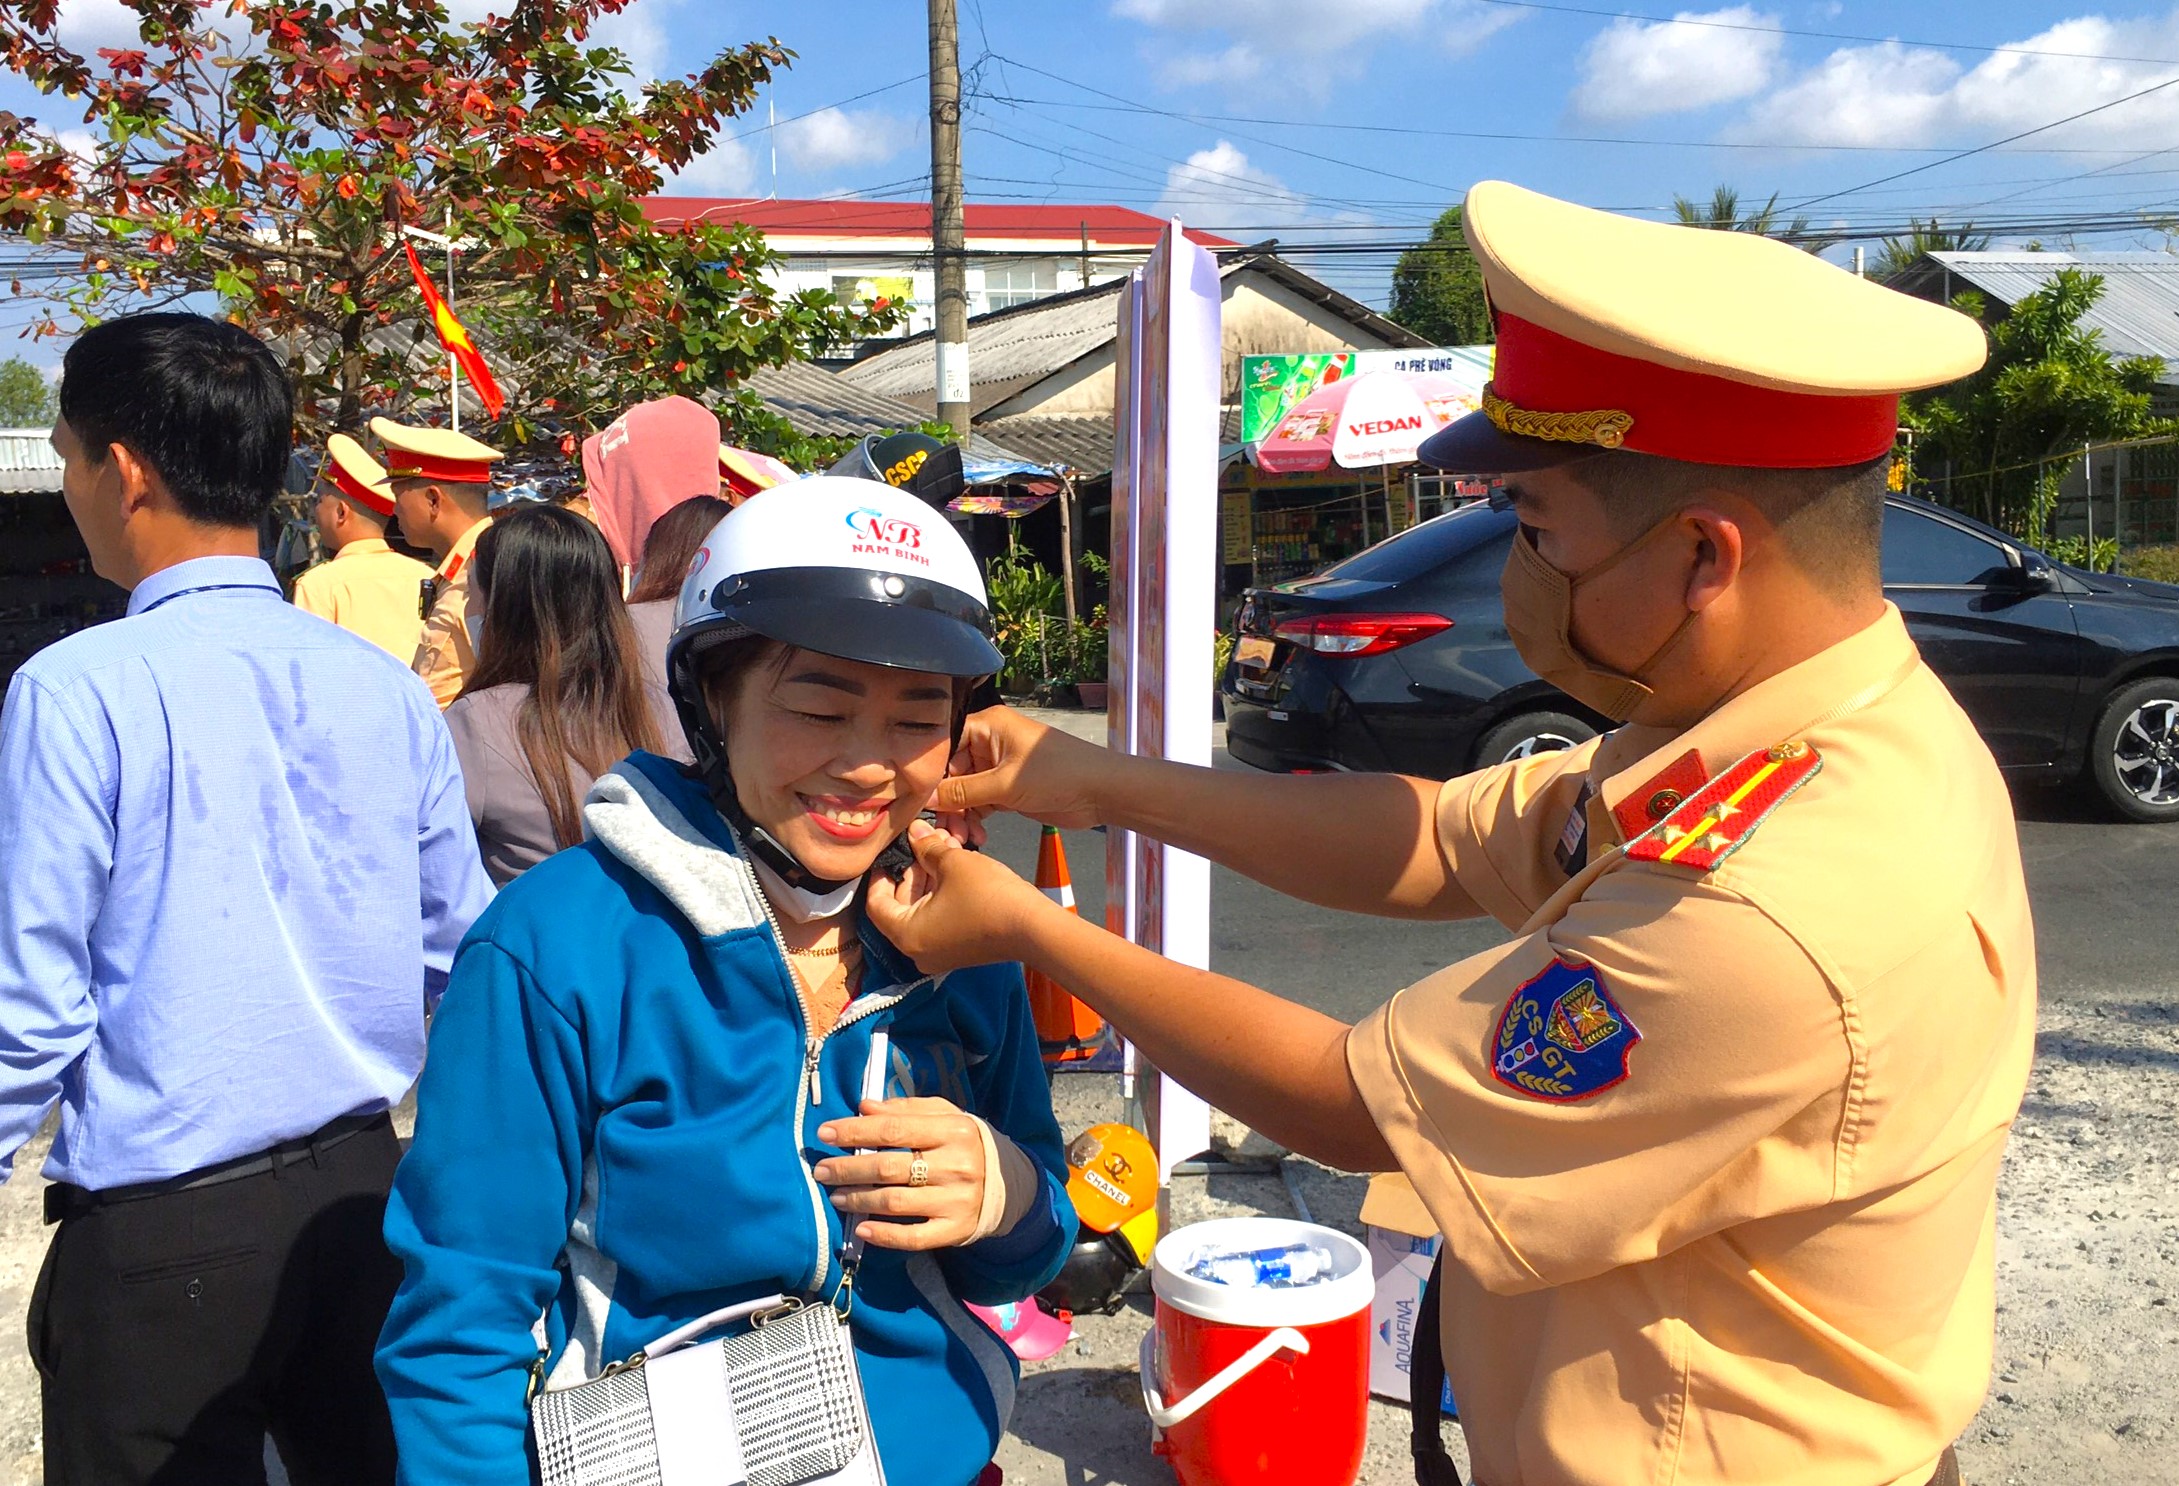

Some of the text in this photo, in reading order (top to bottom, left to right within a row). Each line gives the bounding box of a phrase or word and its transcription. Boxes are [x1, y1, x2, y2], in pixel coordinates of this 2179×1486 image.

[1349, 415, 1422, 437] VEDAN
[856, 518, 921, 549] NB
[852, 544, 930, 567] NAM BINH
[1522, 1000, 1543, 1036] CS
[1542, 1047, 1576, 1078] GT
[1086, 1171, 1127, 1205] CHANEL
[1394, 1297, 1415, 1375] AQUAFINA
